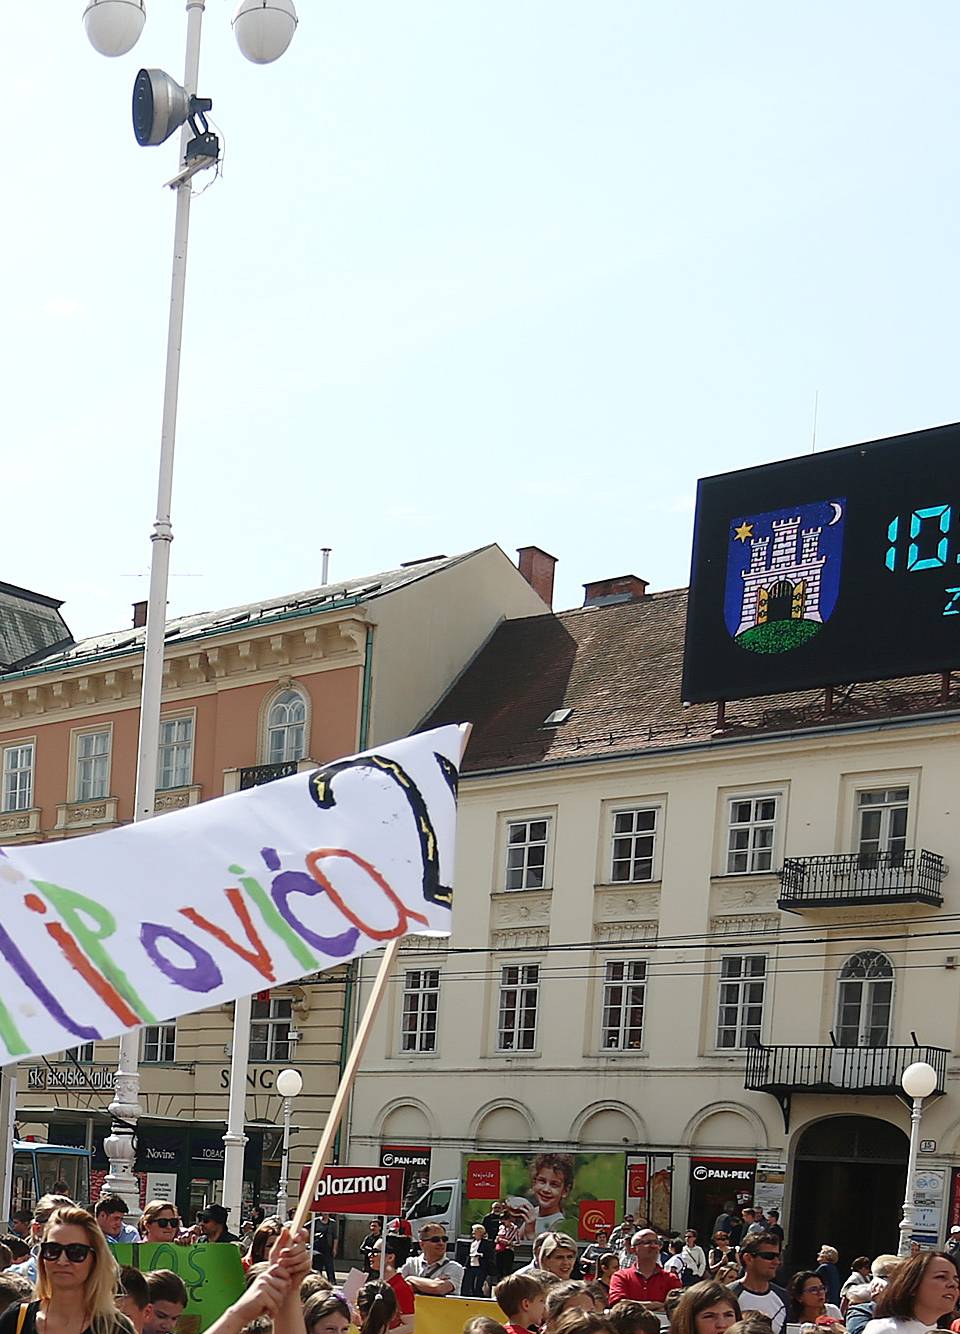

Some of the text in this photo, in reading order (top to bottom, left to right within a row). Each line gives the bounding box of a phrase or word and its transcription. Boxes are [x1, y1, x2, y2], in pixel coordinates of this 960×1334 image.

[220, 1068, 302, 1088] SNG
[146, 1147, 175, 1160] Novine
[708, 1169, 751, 1180] PAN-PEK
[314, 1174, 387, 1201] plazma
